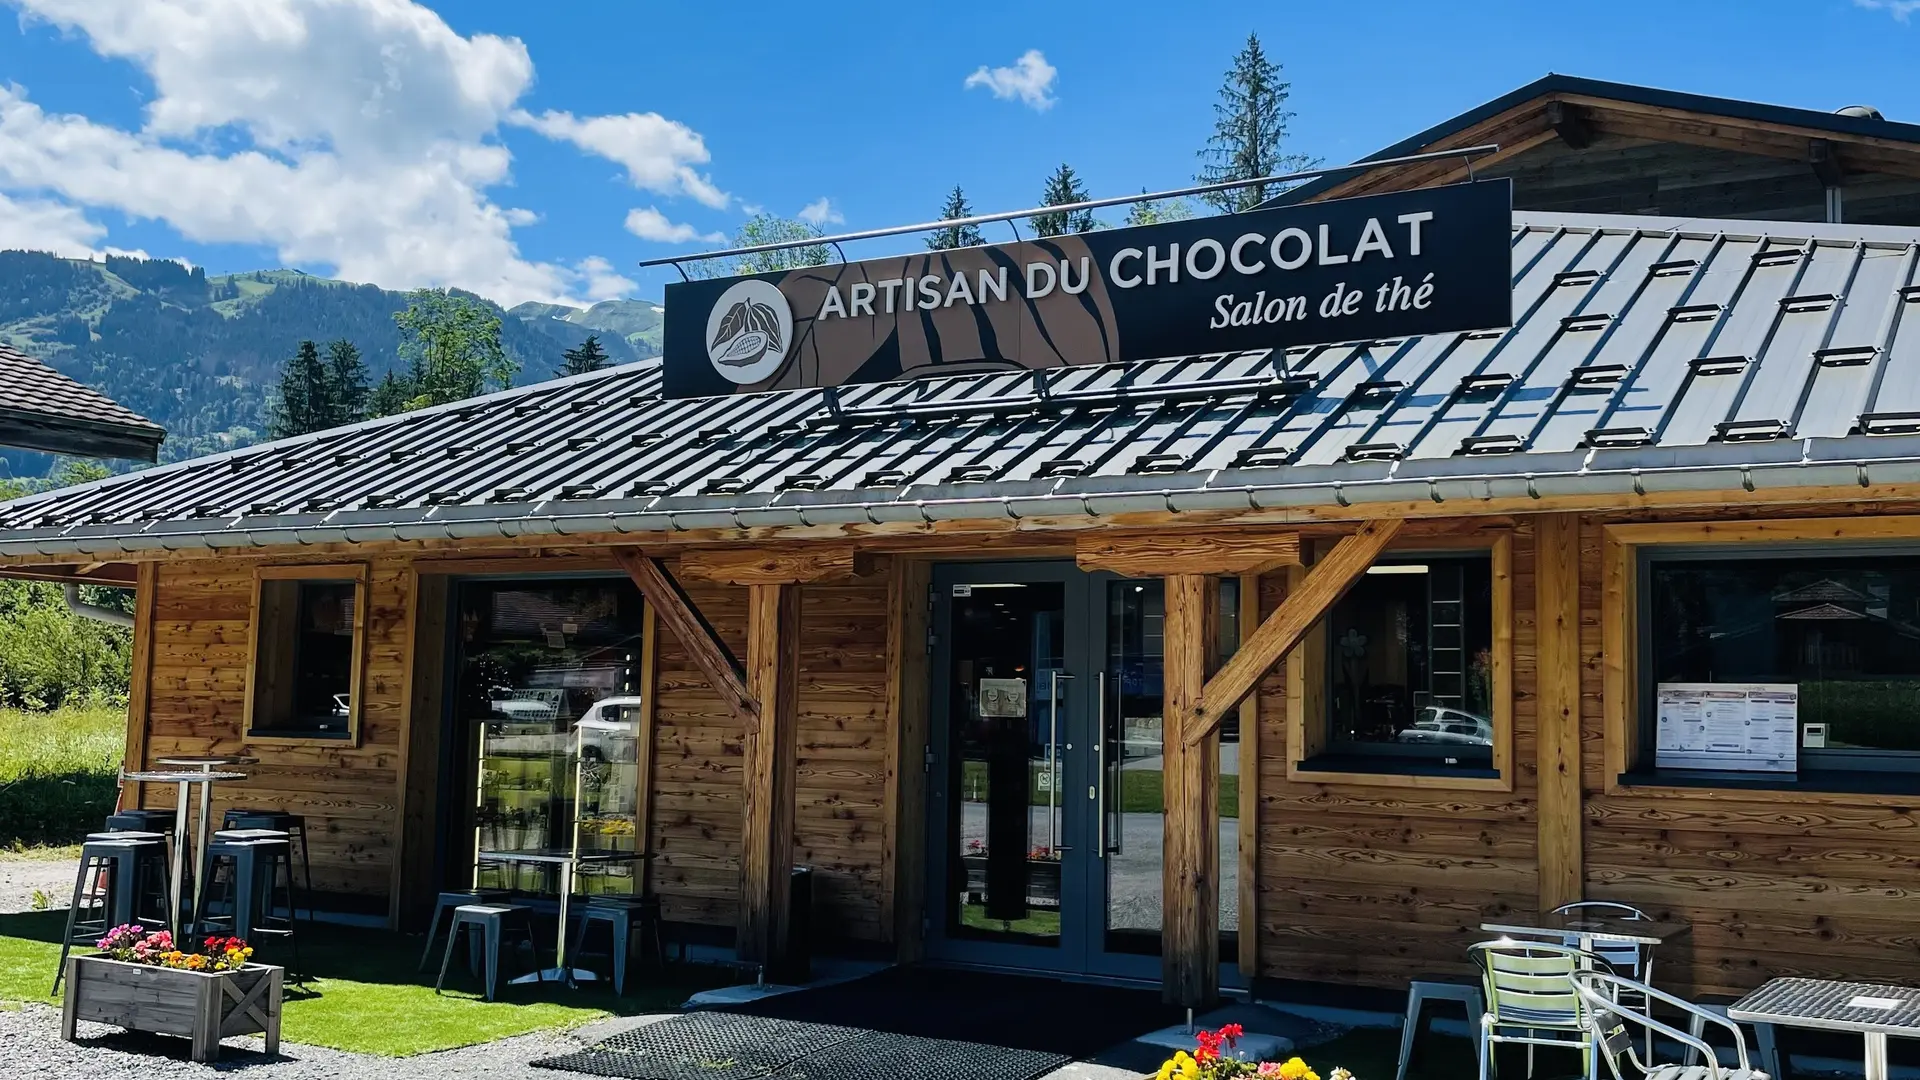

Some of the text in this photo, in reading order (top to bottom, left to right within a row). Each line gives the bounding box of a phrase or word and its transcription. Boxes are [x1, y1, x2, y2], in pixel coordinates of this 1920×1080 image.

[818, 211, 1433, 321] ARTISAN DU CHOCOLAT
[1210, 272, 1435, 329] Salon de thé
